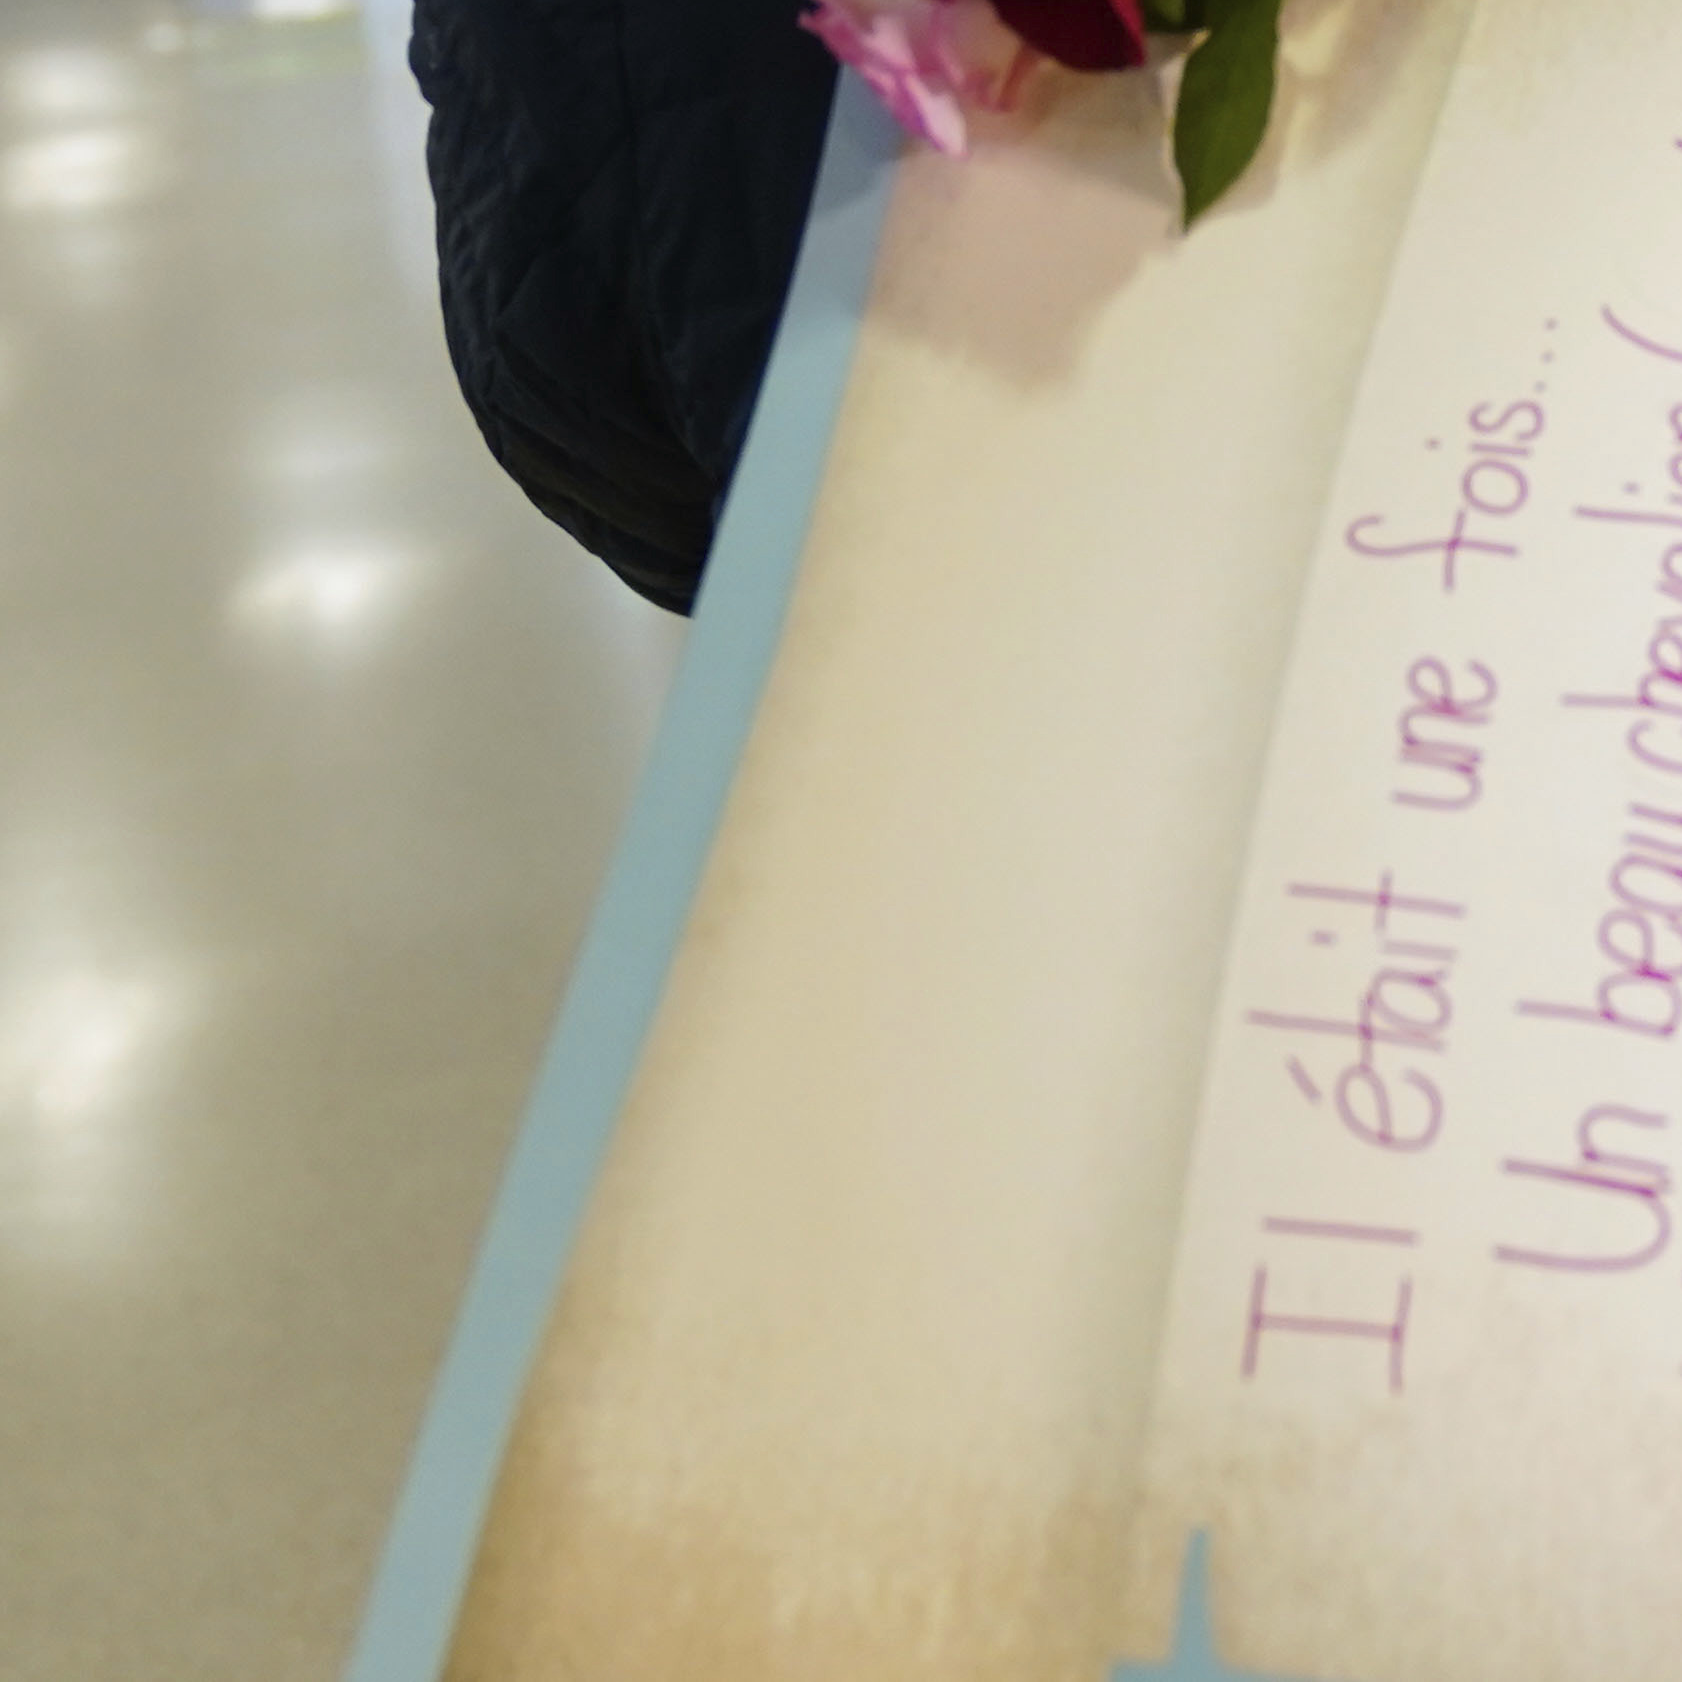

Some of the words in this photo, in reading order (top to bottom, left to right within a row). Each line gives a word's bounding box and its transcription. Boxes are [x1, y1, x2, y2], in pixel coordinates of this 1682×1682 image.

[1345, 316, 1557, 594] fois...
[1390, 654, 1497, 812] une
[1245, 870, 1466, 1152] était
[1493, 1103, 1672, 1273] Un
[1238, 1215, 1420, 1396] Il
